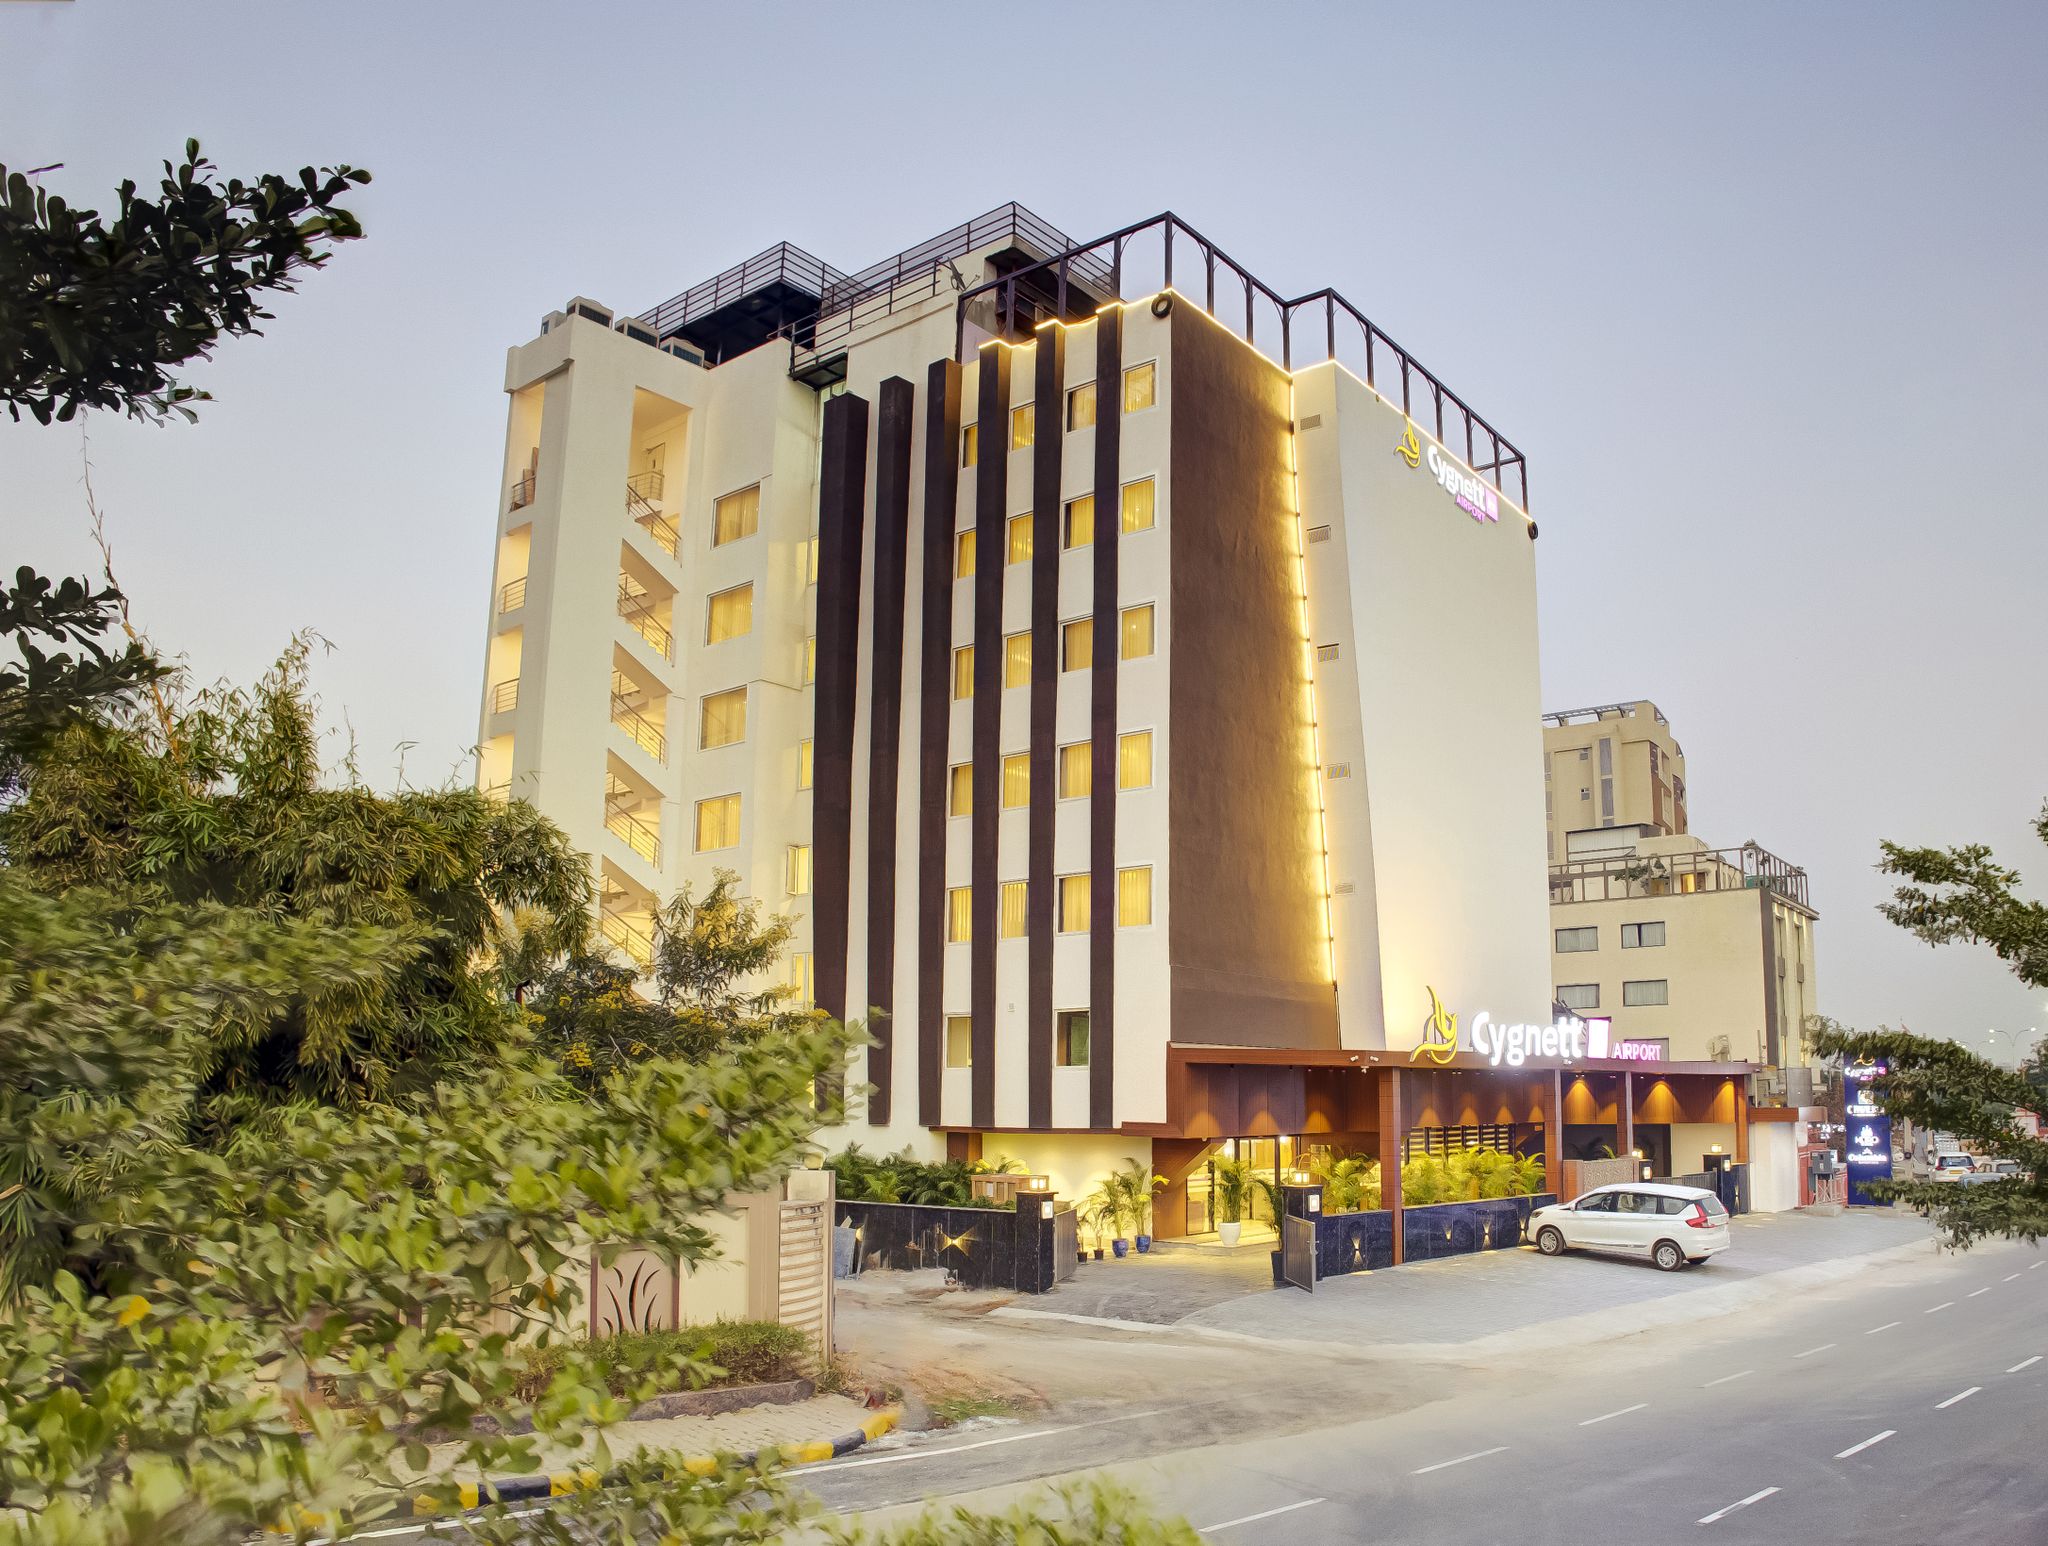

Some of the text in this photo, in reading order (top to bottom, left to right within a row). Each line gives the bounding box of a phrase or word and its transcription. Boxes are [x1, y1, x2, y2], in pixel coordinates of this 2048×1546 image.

[1427, 444, 1486, 513] Cygnett
[1455, 494, 1486, 524] AIRPORT
[1471, 1011, 1661, 1067] Cygnett AIRPORT
